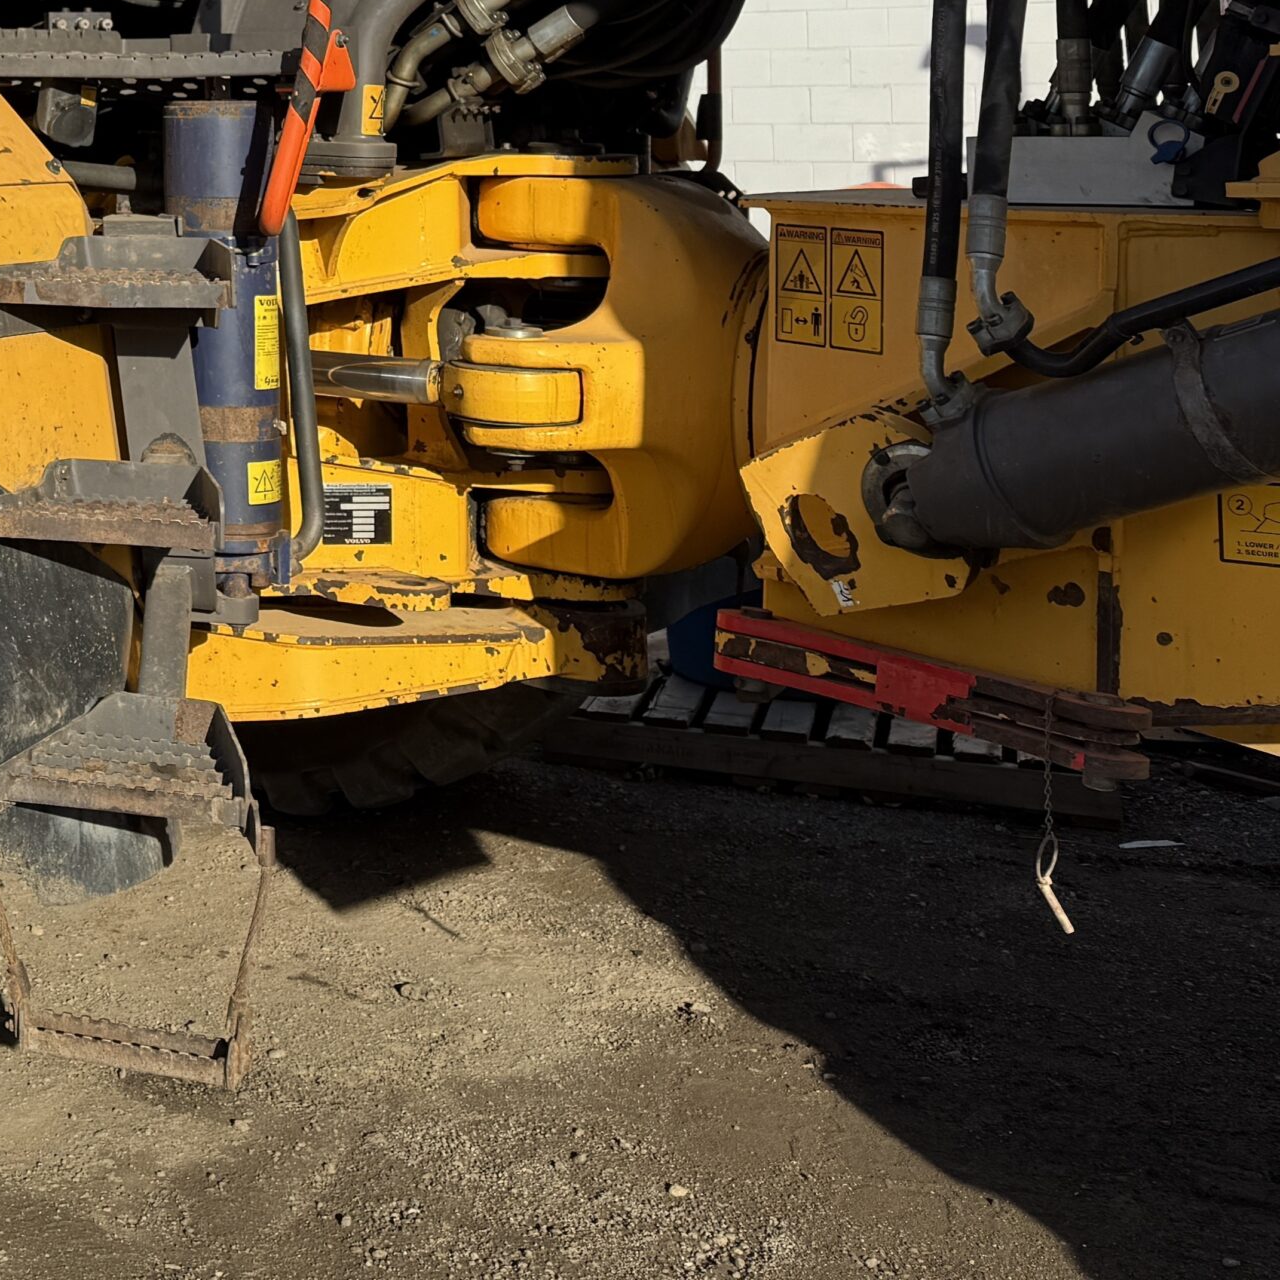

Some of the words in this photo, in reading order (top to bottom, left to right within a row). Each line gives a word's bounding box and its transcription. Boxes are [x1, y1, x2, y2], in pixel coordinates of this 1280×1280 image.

[786, 229, 825, 241] WARNING
[844, 235, 881, 247] WARNING
[1235, 499, 1244, 510] 2
[1245, 549, 1279, 557] SECURE
